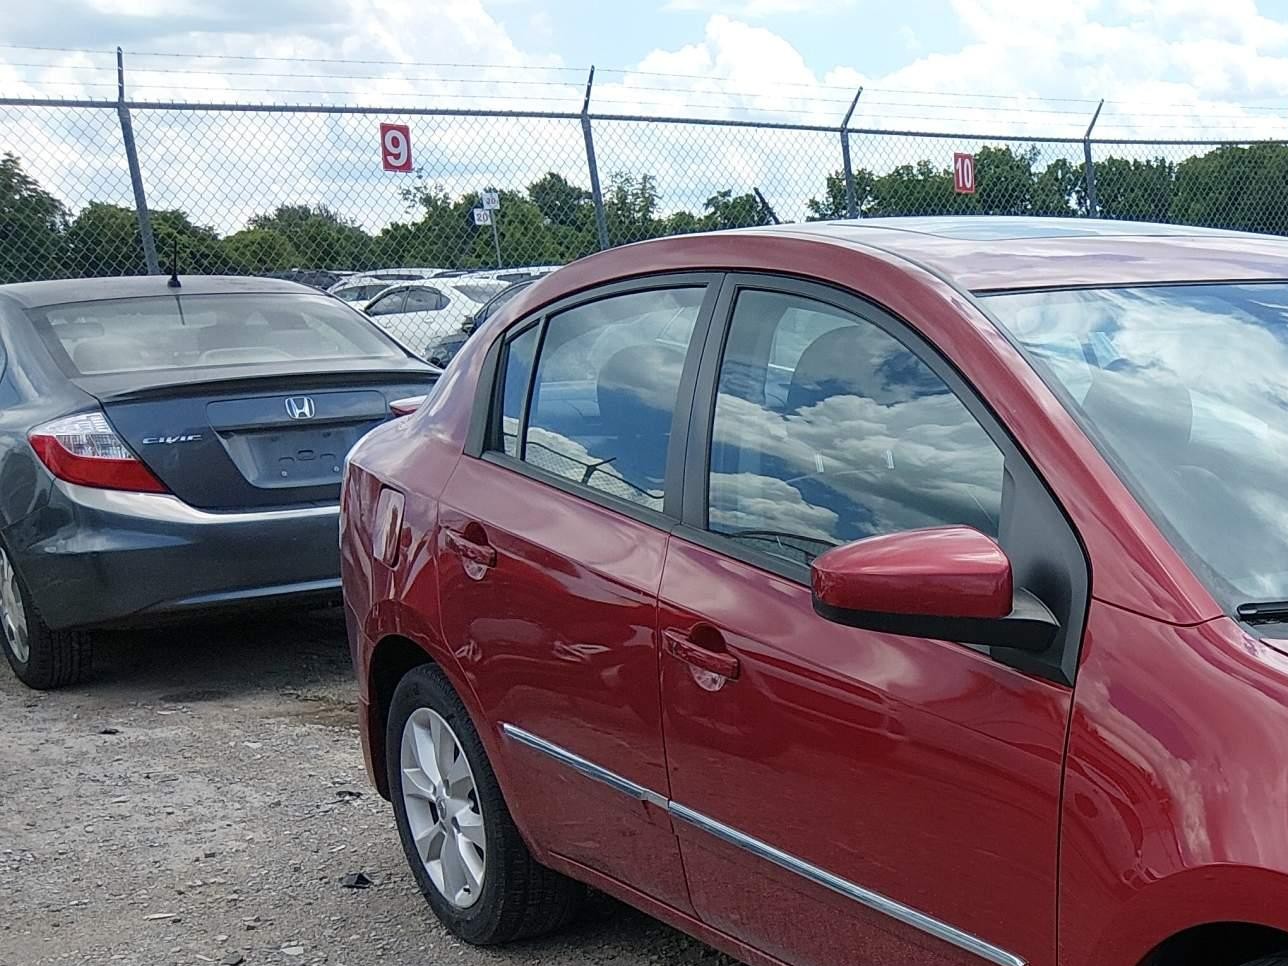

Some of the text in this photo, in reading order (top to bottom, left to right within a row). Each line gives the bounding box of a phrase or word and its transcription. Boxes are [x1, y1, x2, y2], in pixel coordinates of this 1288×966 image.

[384, 129, 408, 167] 9
[956, 157, 972, 189] 10
[142, 434, 203, 444] CIVIC
